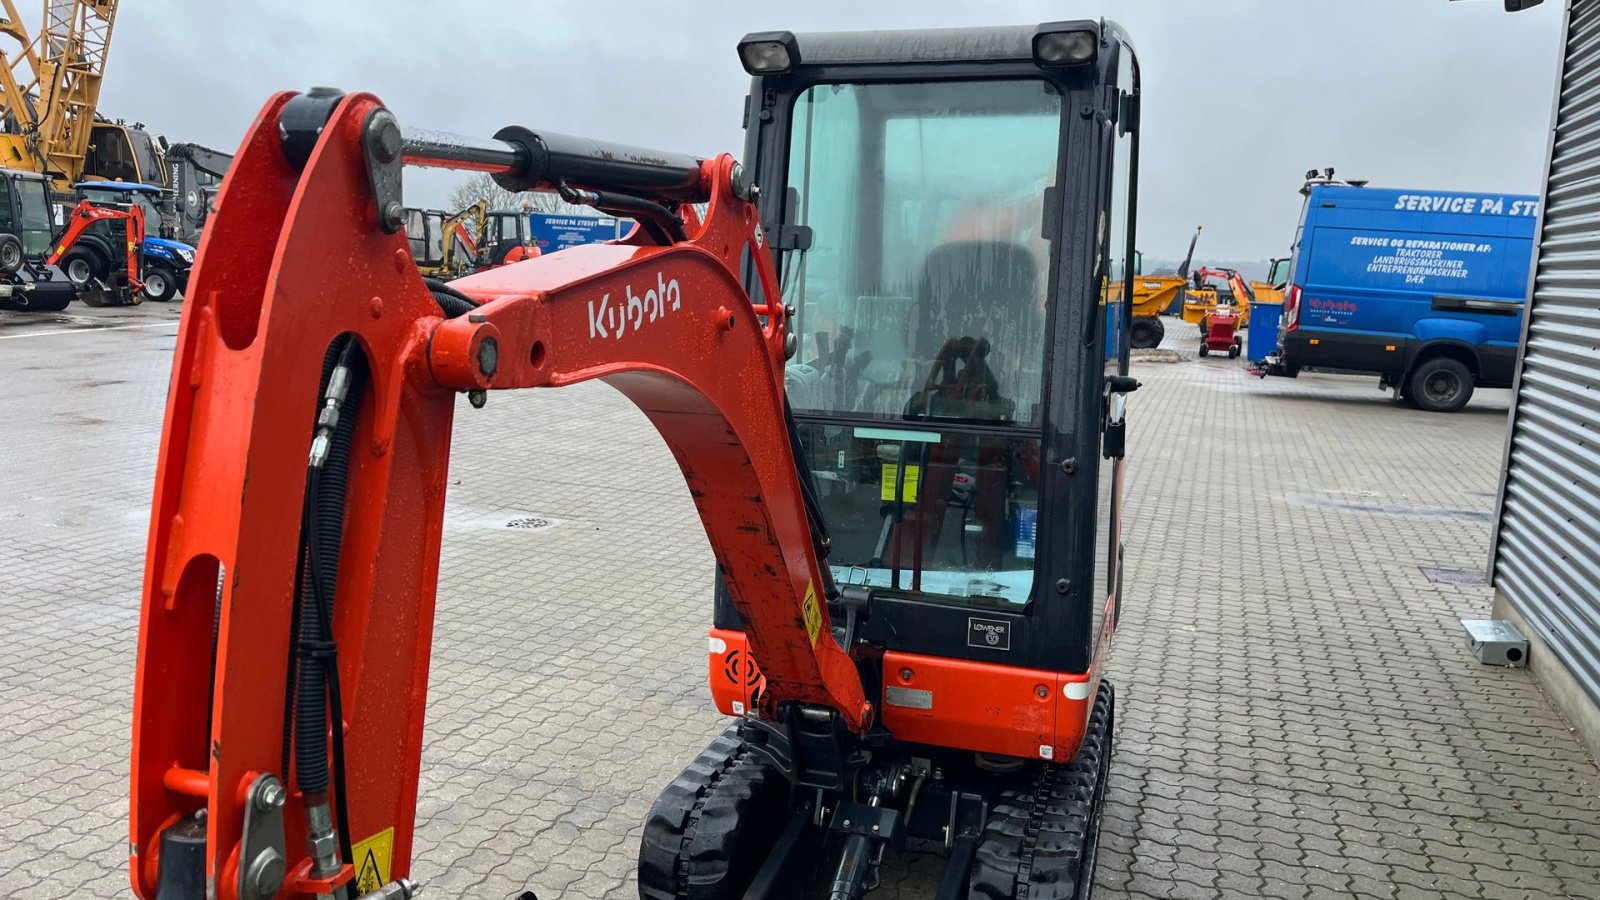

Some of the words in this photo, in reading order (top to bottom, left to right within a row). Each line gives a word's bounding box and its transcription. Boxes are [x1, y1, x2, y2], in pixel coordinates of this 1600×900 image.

[1394, 194, 1477, 213] SERVICE
[1480, 196, 1503, 215] PÅ
[545, 218, 569, 226] SERVICE
[1350, 237, 1389, 247] SERVICE
[1390, 239, 1403, 248] OG
[1405, 240, 1476, 252] REPARATIONER
[1396, 248, 1443, 259] TRAKTORER
[1373, 255, 1464, 269] LANDBRUGSMASKINER
[1366, 263, 1468, 279] ENTREPRENØRMASKINER
[1405, 274, 1426, 284] DÆK
[588, 271, 680, 340] Kubota
[973, 623, 1005, 634] LØWENER
